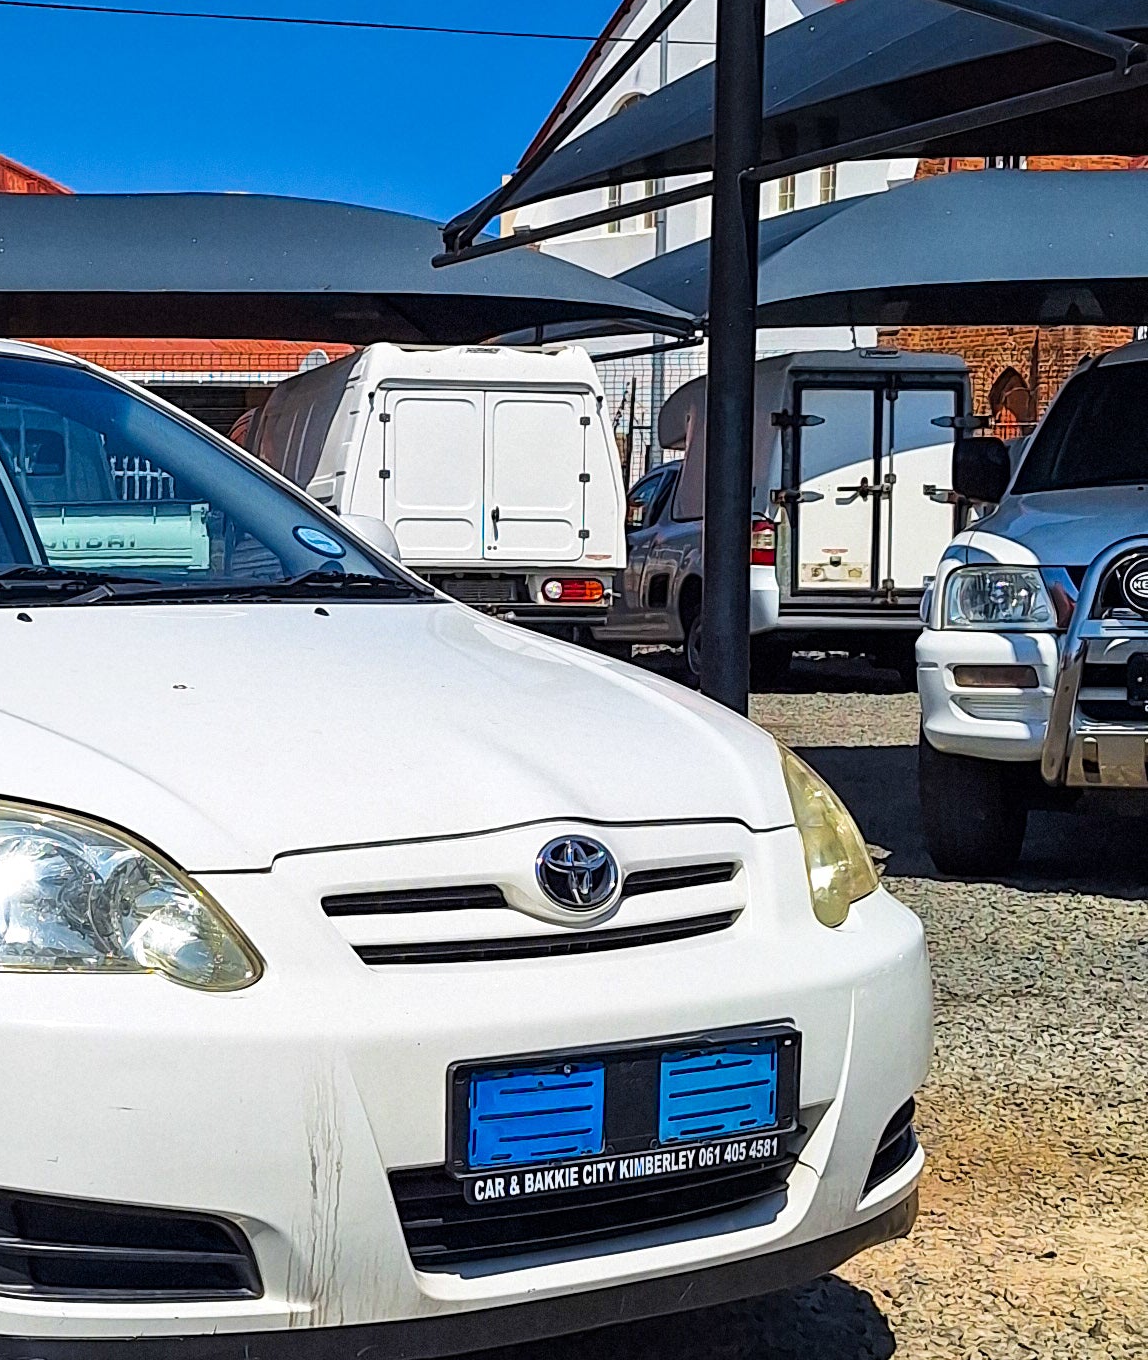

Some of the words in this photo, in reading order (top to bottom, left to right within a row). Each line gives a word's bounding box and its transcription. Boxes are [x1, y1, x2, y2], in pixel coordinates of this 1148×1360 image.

[474, 1177, 505, 1201] CAR
[509, 1175, 520, 1196] &
[524, 1166, 579, 1194] BAKKIE
[582, 1160, 616, 1185] CITY
[619, 1148, 696, 1180] KIMBERLEY
[698, 1145, 721, 1167] 061
[724, 1141, 747, 1163] 405
[749, 1137, 778, 1159] 4581
